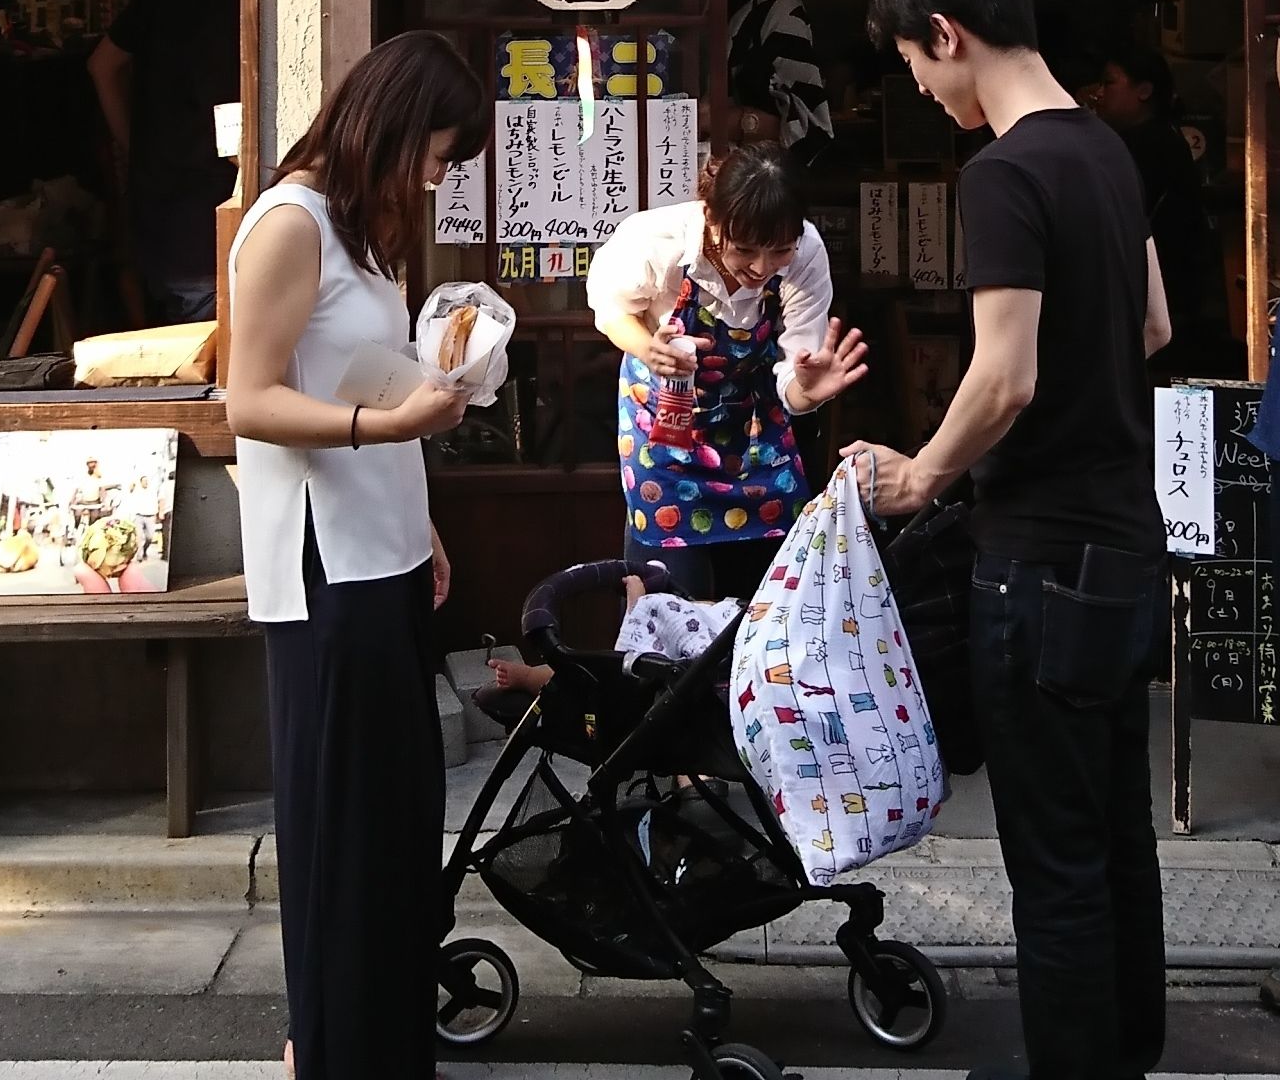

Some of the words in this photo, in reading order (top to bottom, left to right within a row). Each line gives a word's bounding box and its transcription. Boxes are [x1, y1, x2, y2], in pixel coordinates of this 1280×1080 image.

[505, 115, 529, 218] はちみつレモンソーダ
[548, 128, 573, 203] レモンビール
[601, 107, 629, 214] ハートランド生ビール
[656, 135, 678, 197] チュロス
[499, 220, 542, 241] 300円
[545, 218, 587, 239] 400円
[593, 219, 620, 239] 40
[1166, 431, 1194, 498] チュロス
